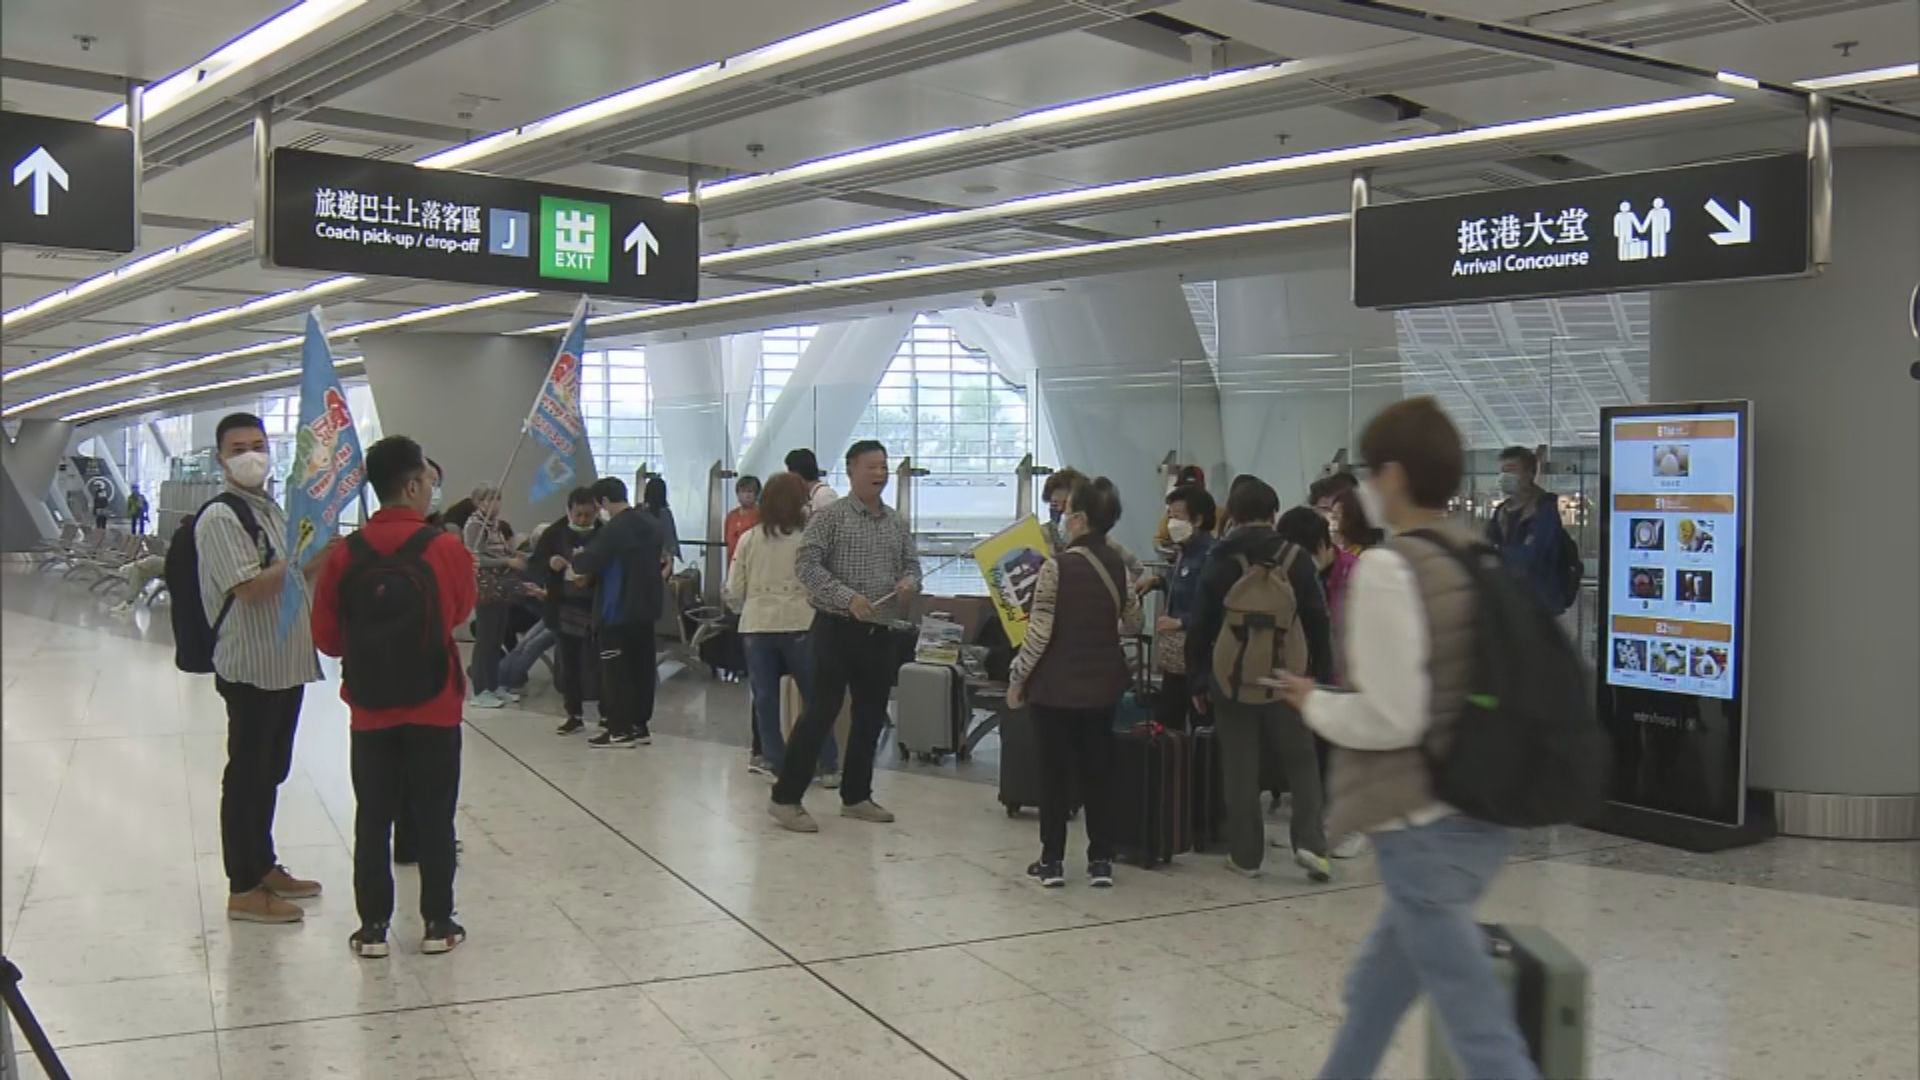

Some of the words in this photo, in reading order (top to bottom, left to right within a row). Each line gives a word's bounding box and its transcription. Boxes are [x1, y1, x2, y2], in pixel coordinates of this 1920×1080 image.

[315, 188, 481, 233] 旅遊巴士上落客區
[315, 222, 360, 241] Coach
[363, 228, 415, 249] pick-up
[416, 233, 423, 248] /
[425, 235, 481, 253] drop-off
[501, 218, 516, 250] J
[555, 210, 595, 254] 出
[1457, 208, 1589, 255] 抵港大堂
[555, 252, 595, 270] EXIT
[1451, 256, 1501, 276] Arrival
[1504, 251, 1589, 271] Concourse
